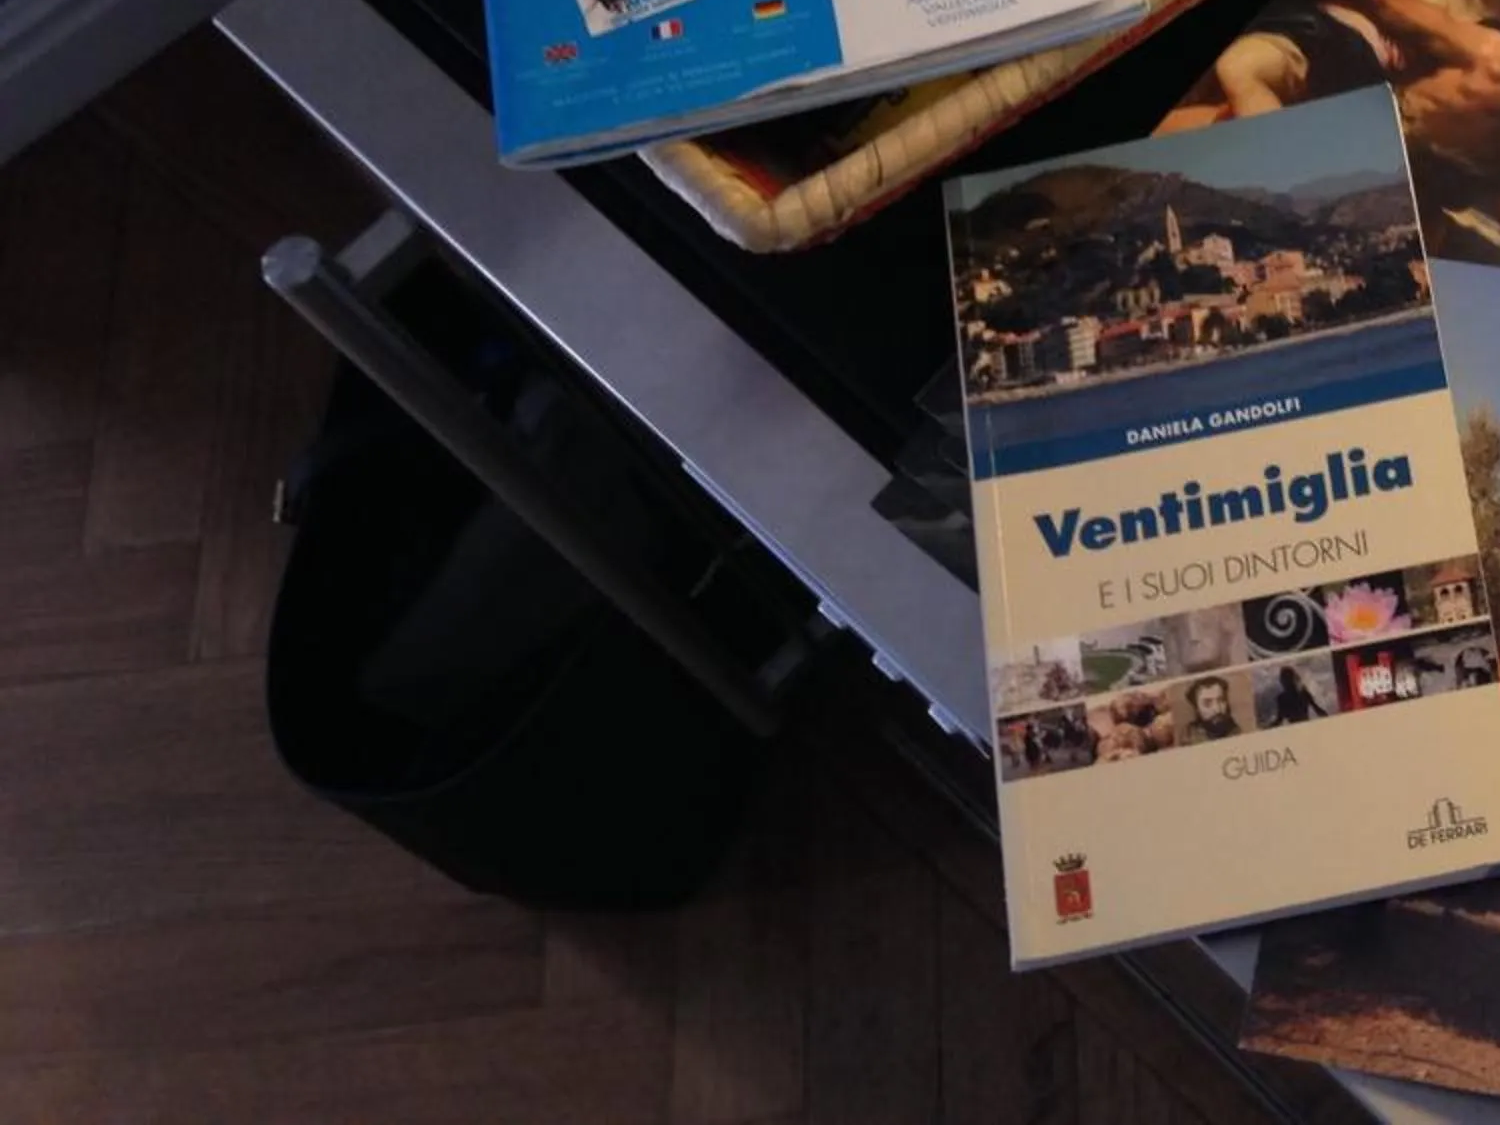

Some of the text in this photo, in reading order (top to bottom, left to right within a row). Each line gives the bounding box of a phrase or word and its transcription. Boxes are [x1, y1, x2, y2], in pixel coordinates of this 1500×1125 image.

[1126, 396, 1302, 446] DANIELA GANDOLFI
[1033, 447, 1415, 559] Ventimiglia
[1099, 530, 1371, 611] E I SUOI DINTORNI
[1221, 745, 1299, 782] GUIDA
[1407, 822, 1489, 851] DE FERRARI
